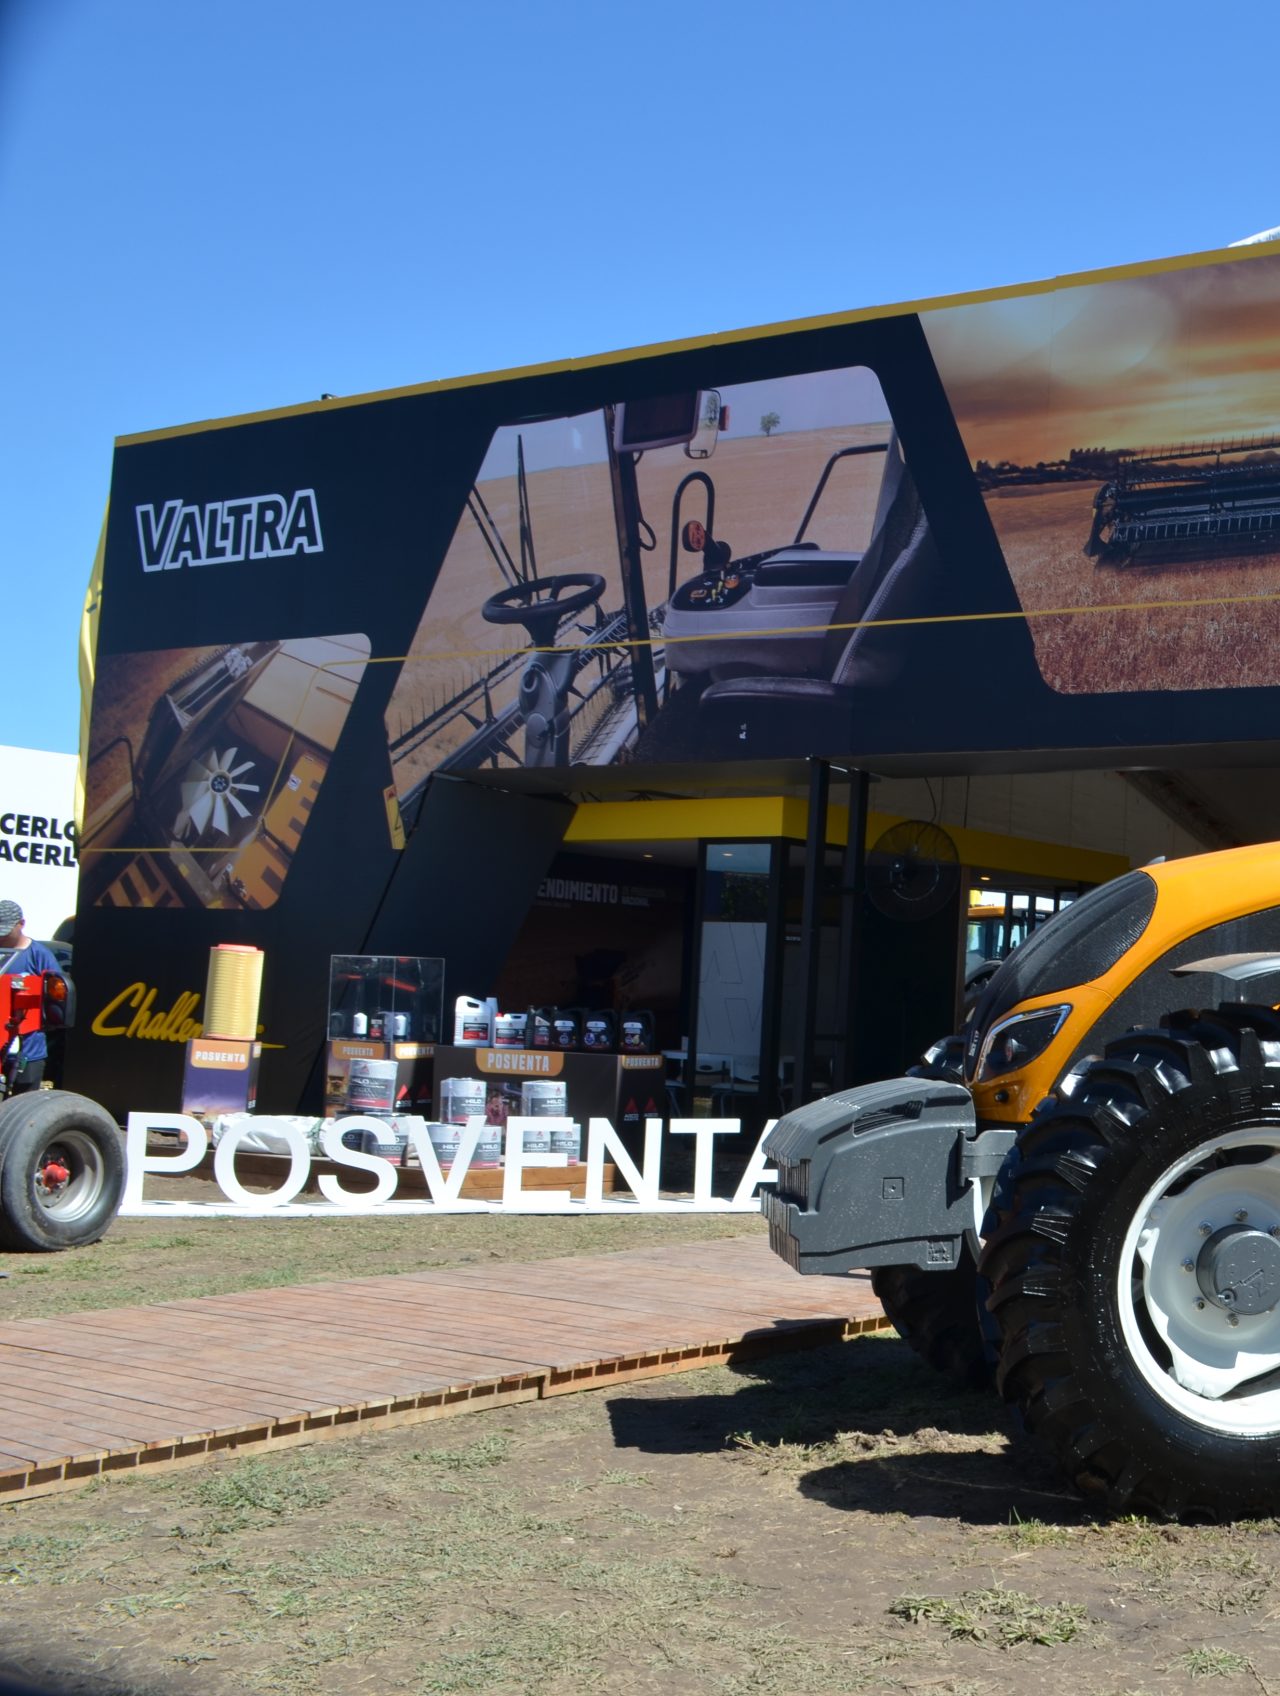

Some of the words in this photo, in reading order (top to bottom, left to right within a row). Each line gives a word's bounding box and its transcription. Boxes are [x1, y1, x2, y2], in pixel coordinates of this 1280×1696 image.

[135, 488, 324, 573] VALTRA
[195, 1051, 246, 1065] POSVENTA
[488, 1053, 550, 1072] POSVENTA
